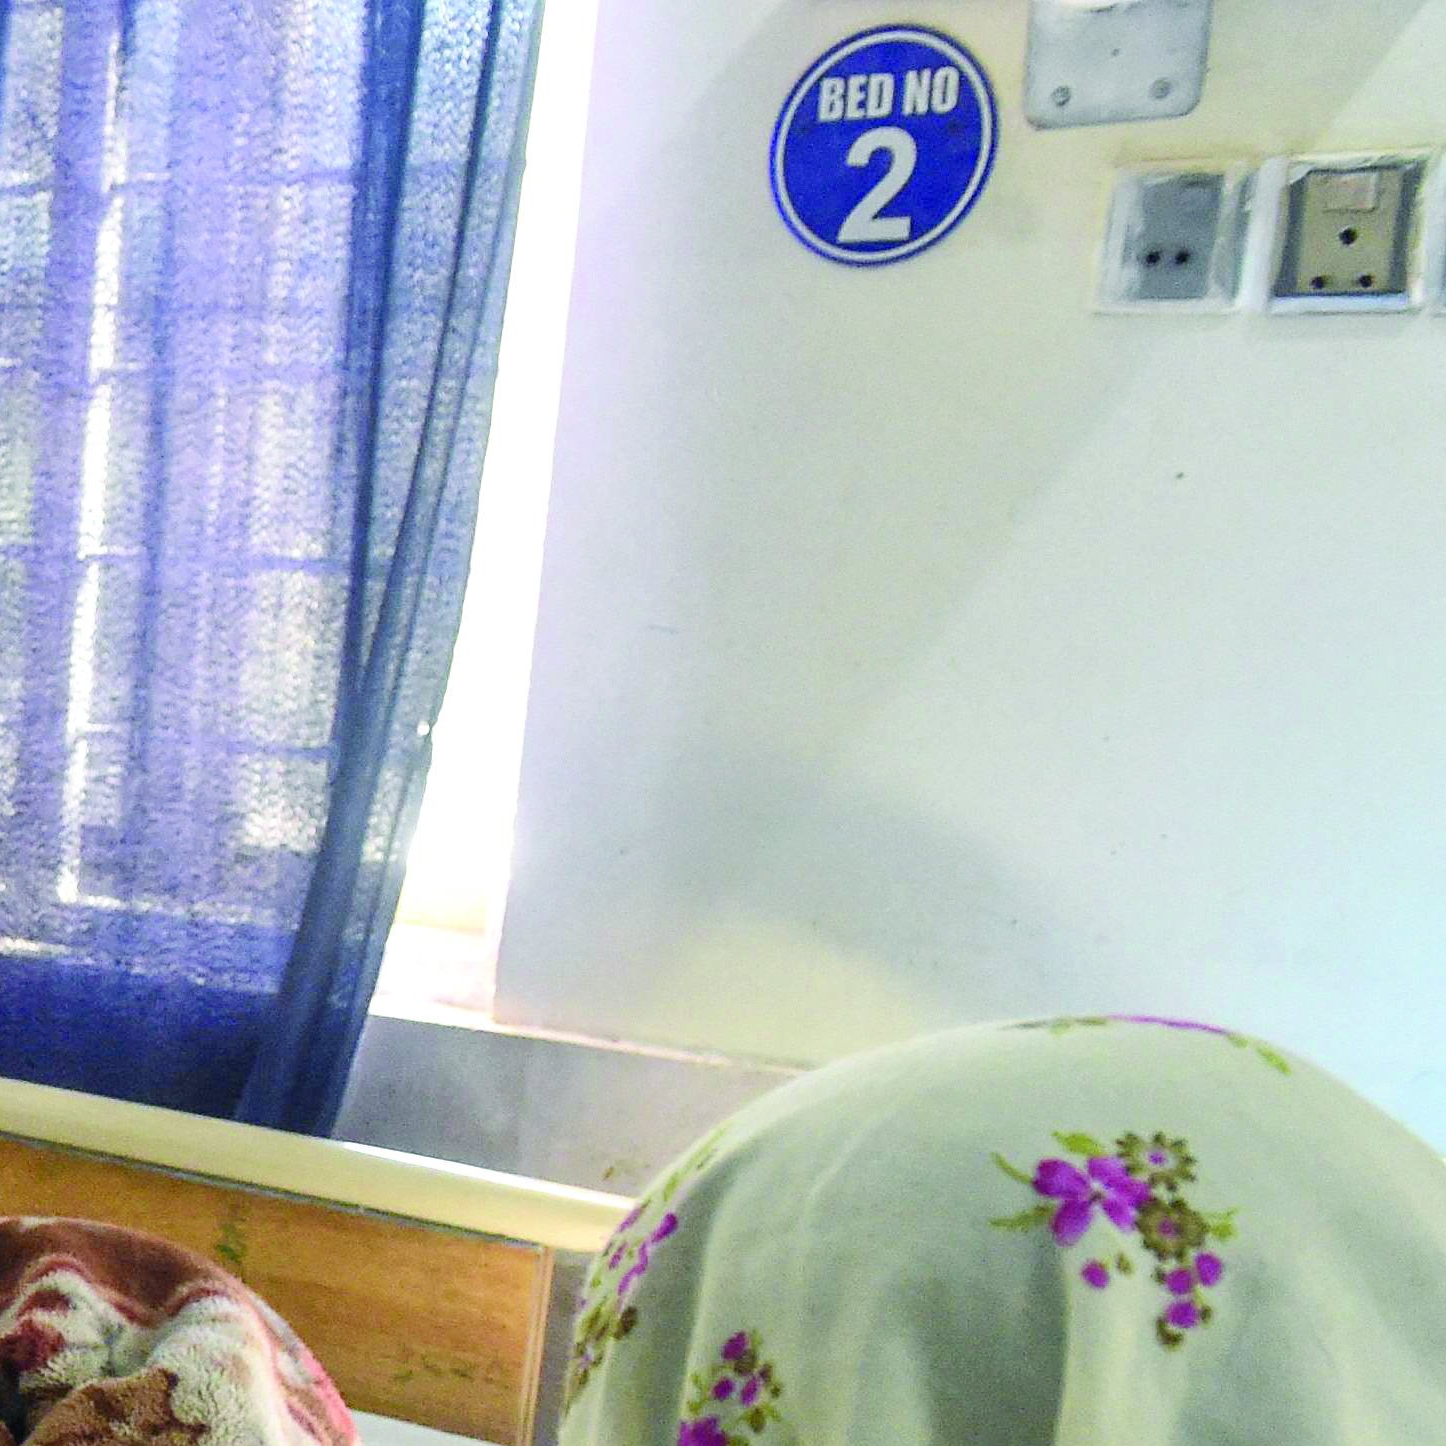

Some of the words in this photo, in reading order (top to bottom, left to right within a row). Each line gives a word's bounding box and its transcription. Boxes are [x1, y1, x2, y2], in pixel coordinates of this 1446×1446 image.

[818, 73, 893, 123] BED
[902, 65, 962, 115] NO
[836, 126, 918, 244] 2
